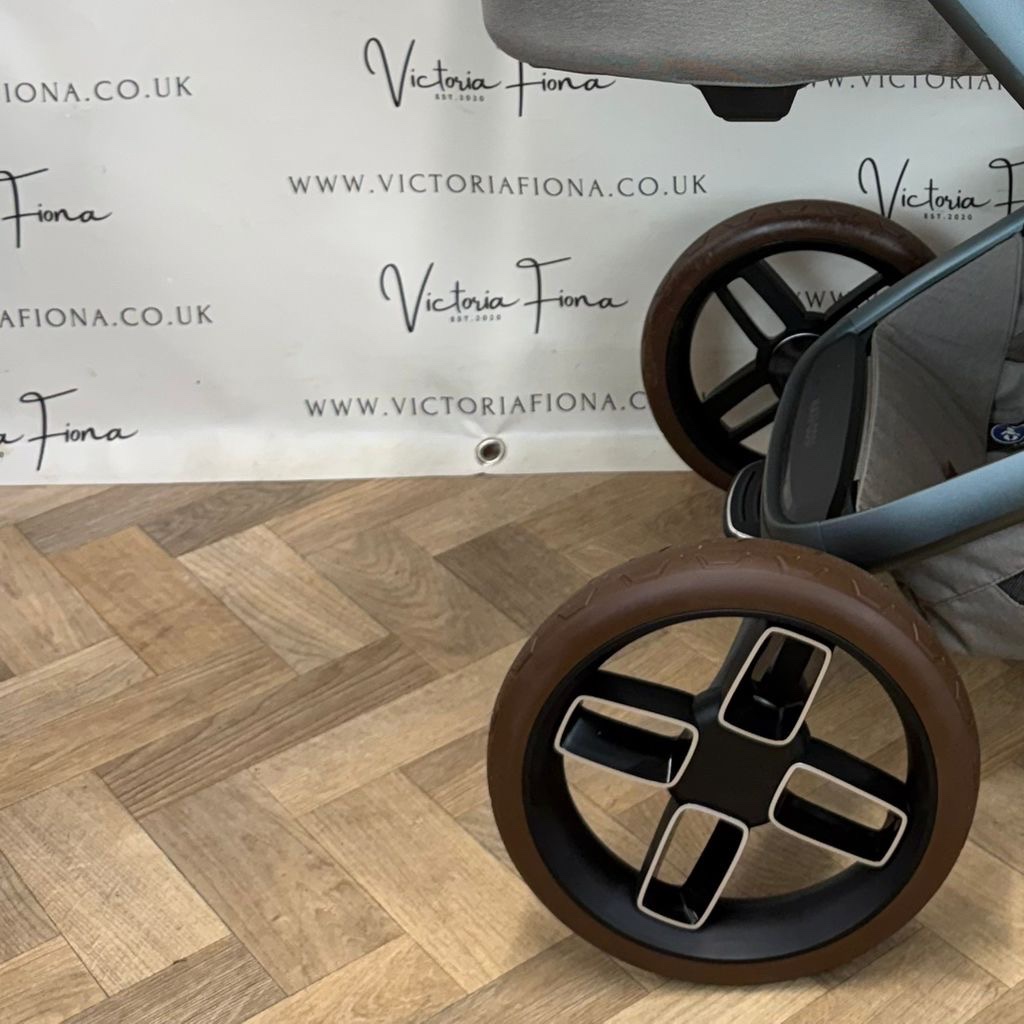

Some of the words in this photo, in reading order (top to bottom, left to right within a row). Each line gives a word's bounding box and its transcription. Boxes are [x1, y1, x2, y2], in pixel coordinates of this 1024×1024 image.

[364, 37, 502, 108] Victoria
[288, 173, 707, 197] WWW.VICTORIAFIONA.CO.UK
[858, 157, 992, 218] Victoria
[924, 212, 973, 221] EST.2020
[379, 262, 521, 333] Victoria
[516, 256, 629, 334] Fiona
[19, 388, 139, 471] Fiona
